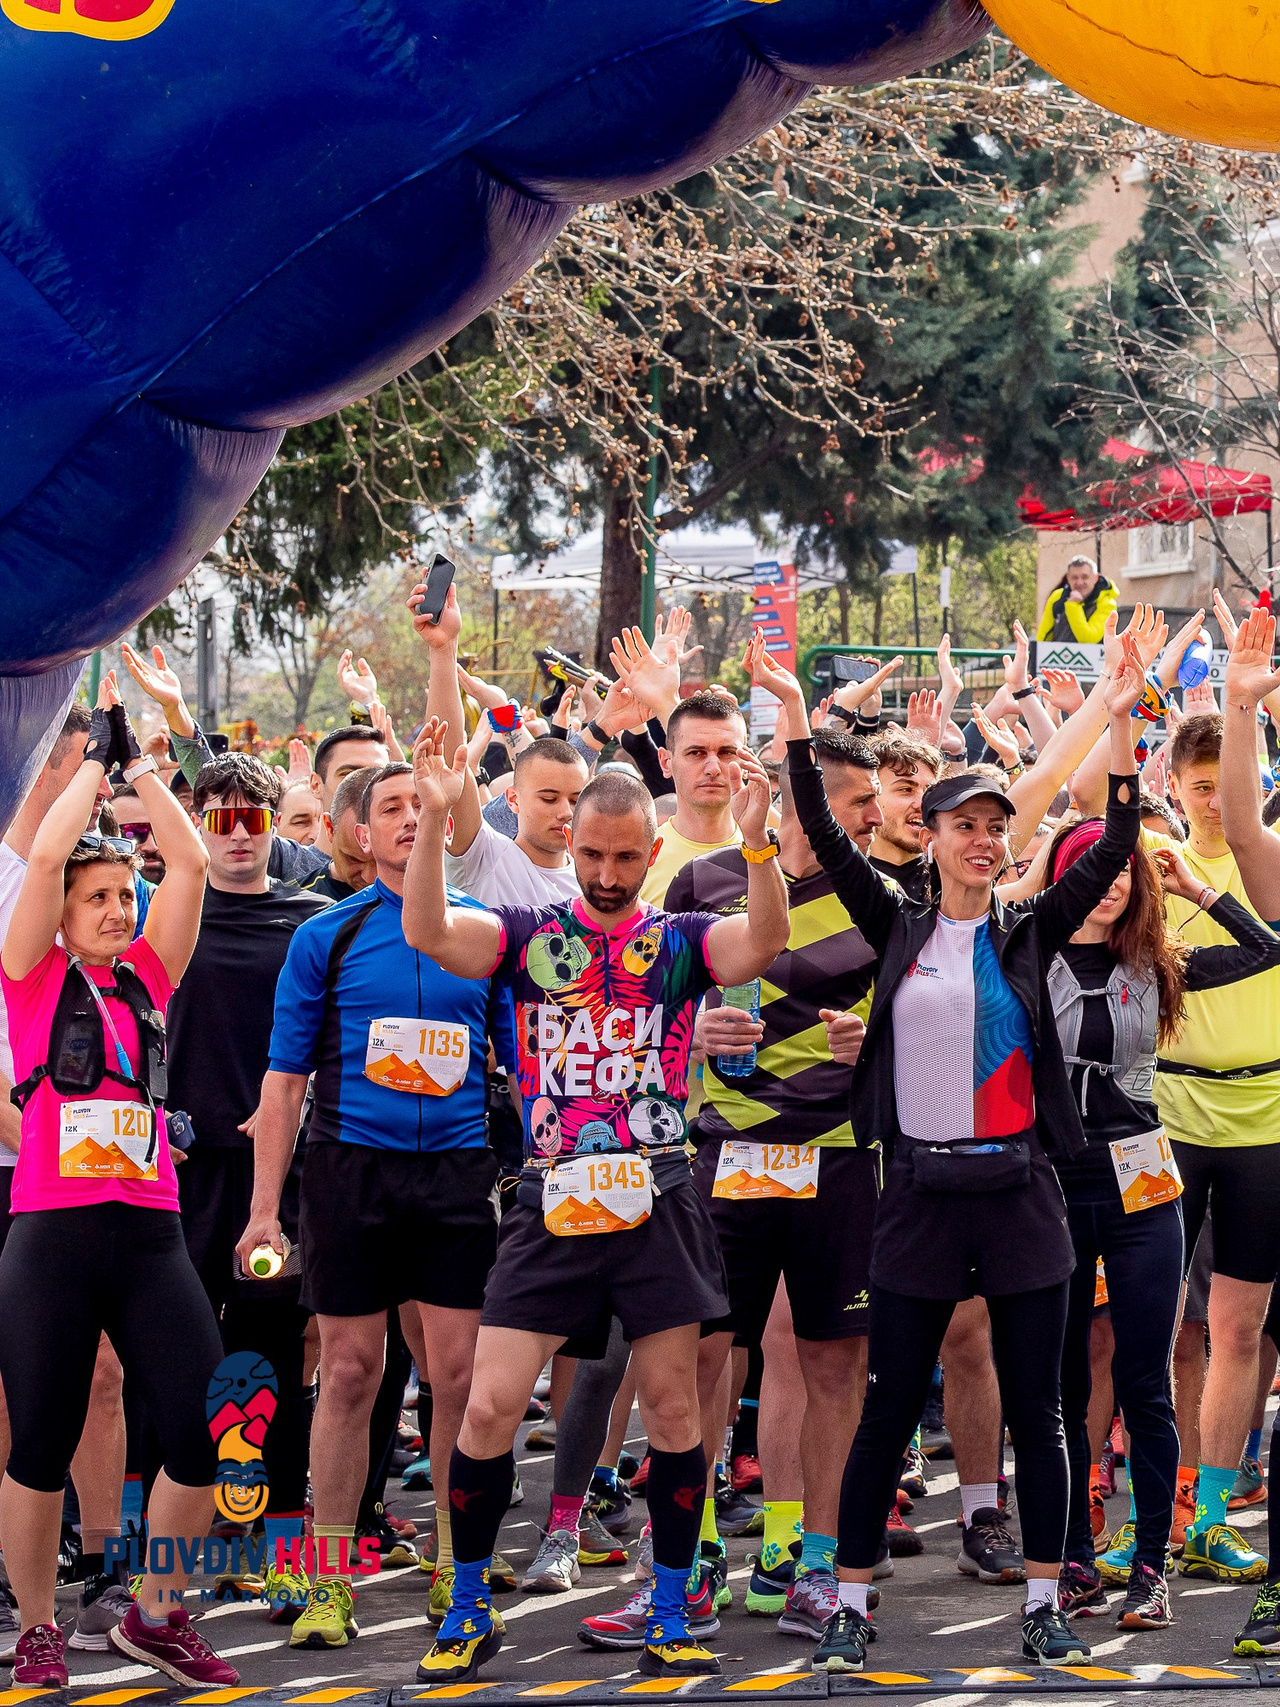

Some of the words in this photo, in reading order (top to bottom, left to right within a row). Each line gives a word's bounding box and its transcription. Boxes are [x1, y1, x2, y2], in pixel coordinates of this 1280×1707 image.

[538, 1003, 663, 1051] БАСИ
[372, 1038, 384, 1047] 12K
[419, 1028, 464, 1058] 1135
[539, 1049, 666, 1096] КЕФА
[111, 1108, 152, 1138] 120
[762, 1144, 815, 1170] 1234
[1118, 1161, 1131, 1171] 12K
[548, 1183, 560, 1192] 12K
[588, 1161, 645, 1191] 1345
